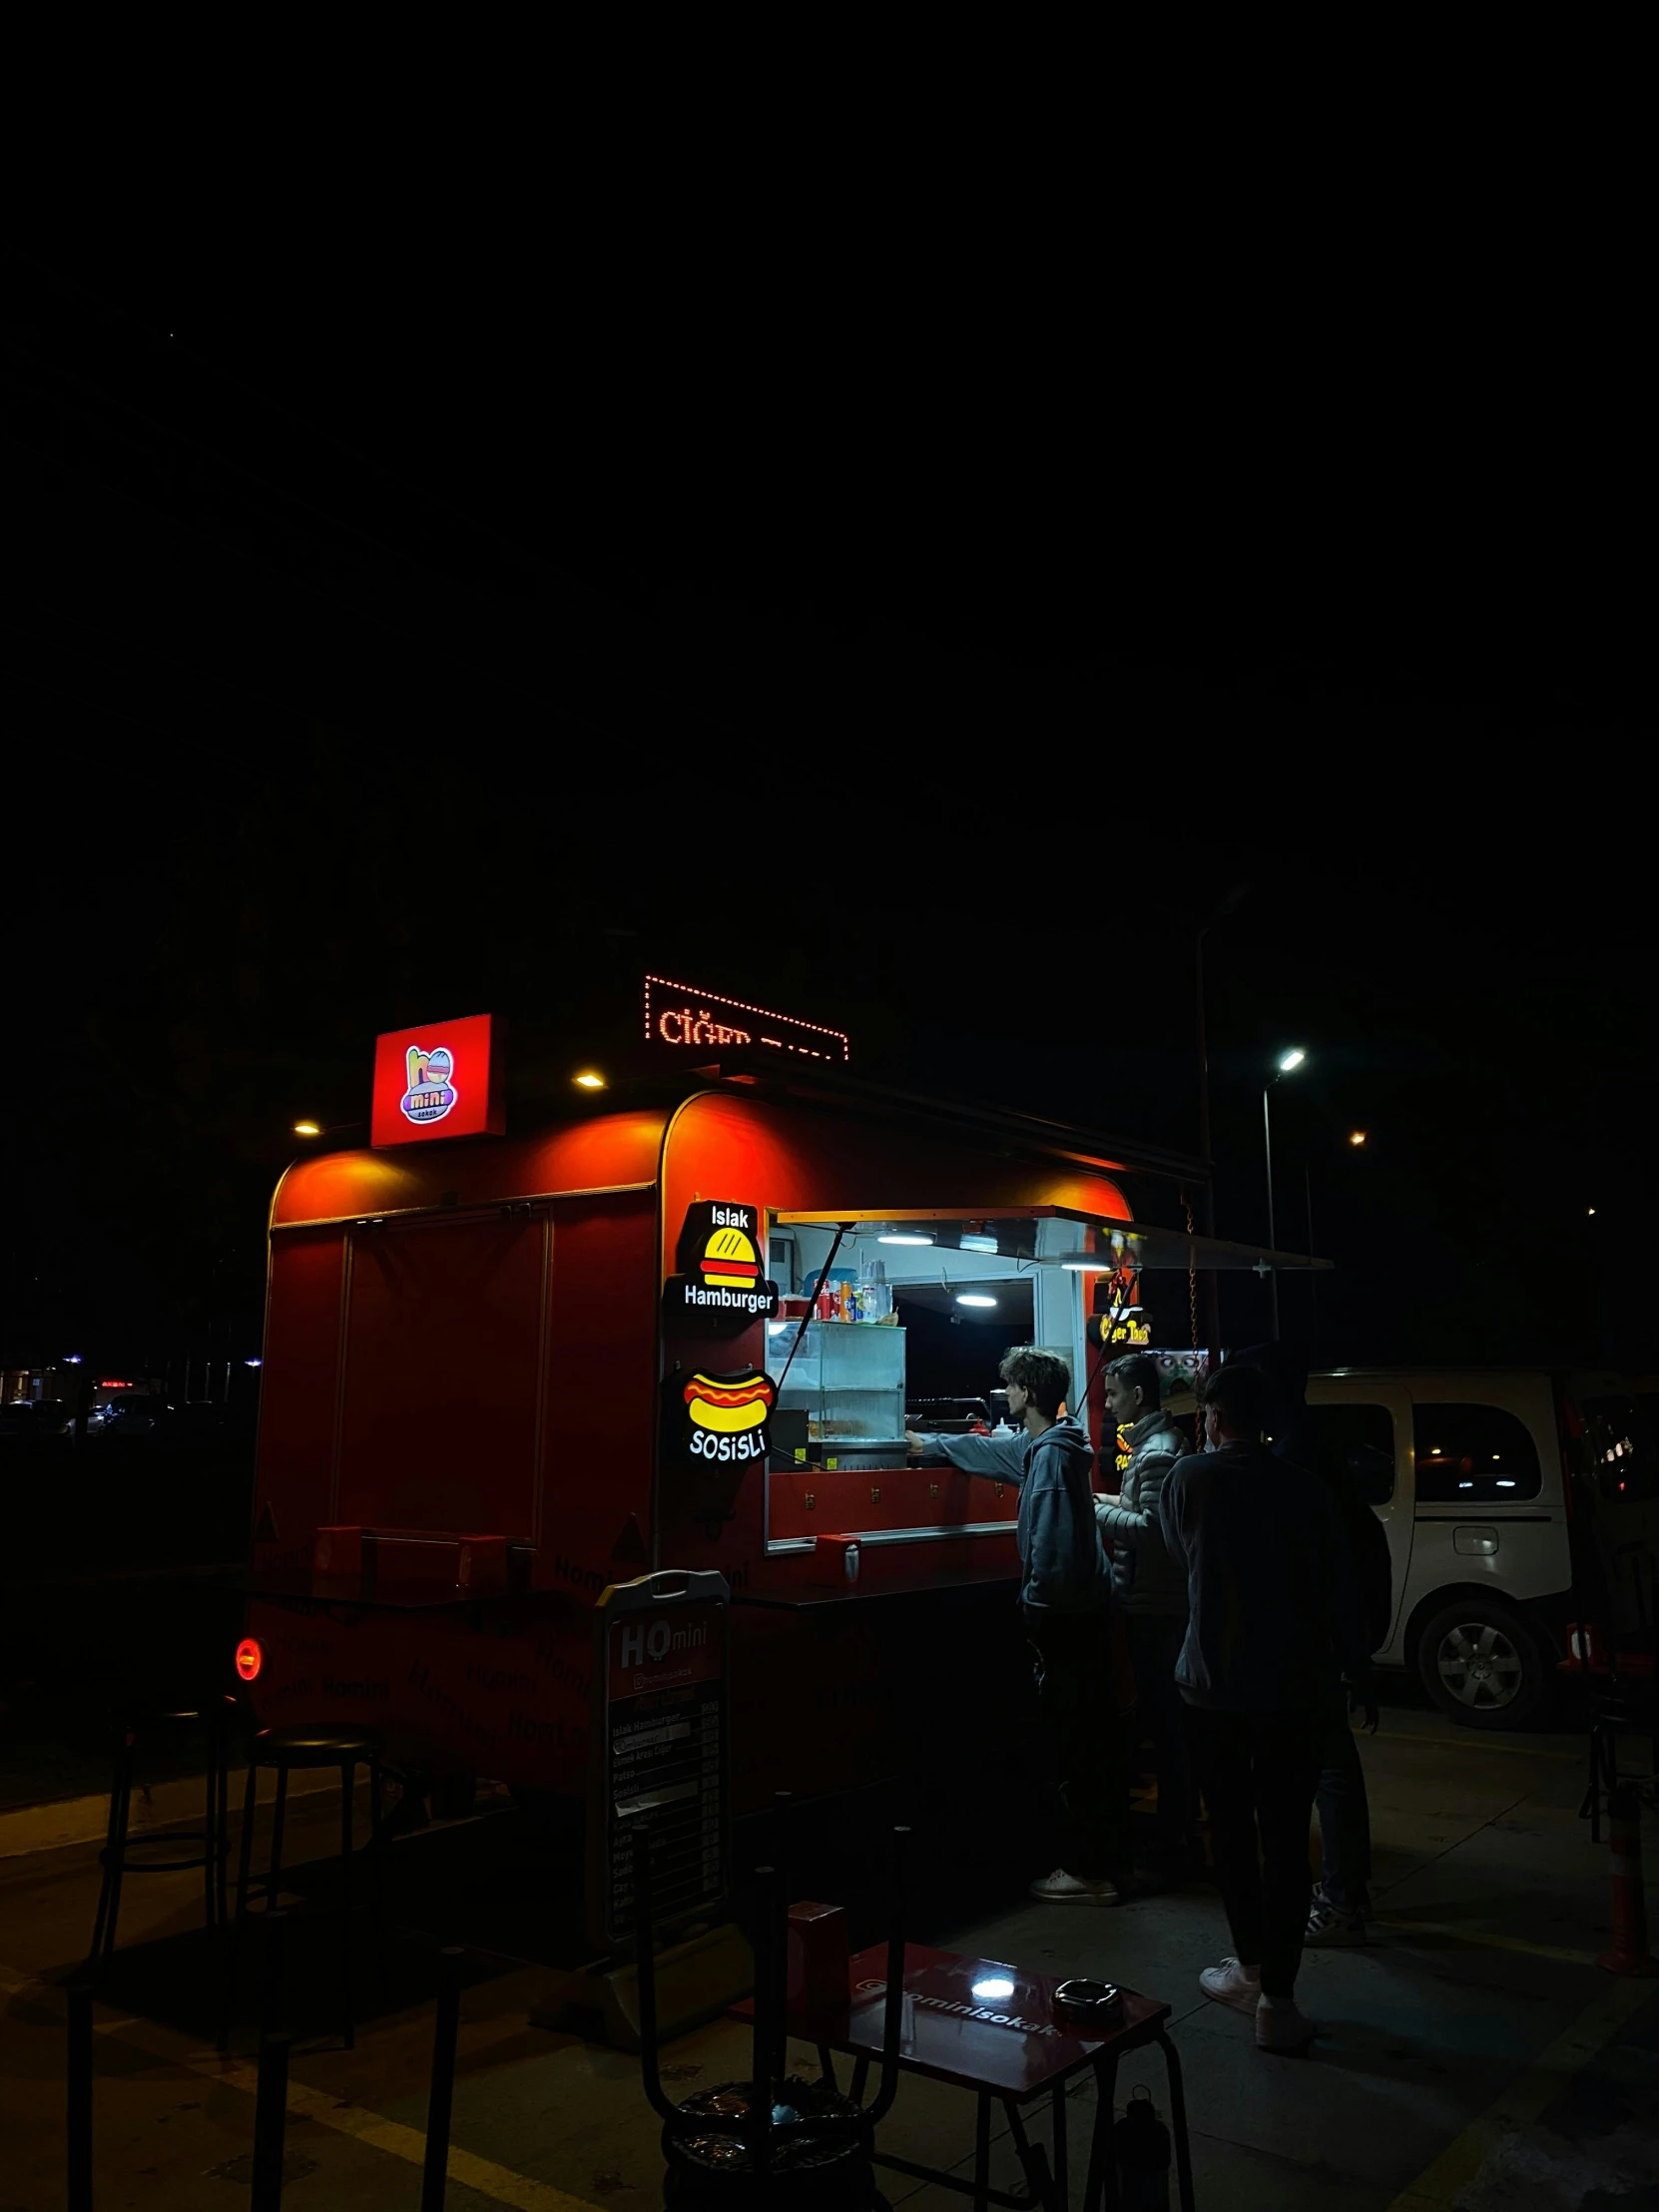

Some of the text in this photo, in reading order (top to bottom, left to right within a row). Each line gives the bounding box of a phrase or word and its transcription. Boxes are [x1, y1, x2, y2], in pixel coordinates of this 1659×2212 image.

[410, 1090, 446, 1109] mini
[712, 1206, 749, 1228] Islak
[685, 1285, 773, 1314] Hamburger
[633, 1713, 681, 1731] Hamburger
